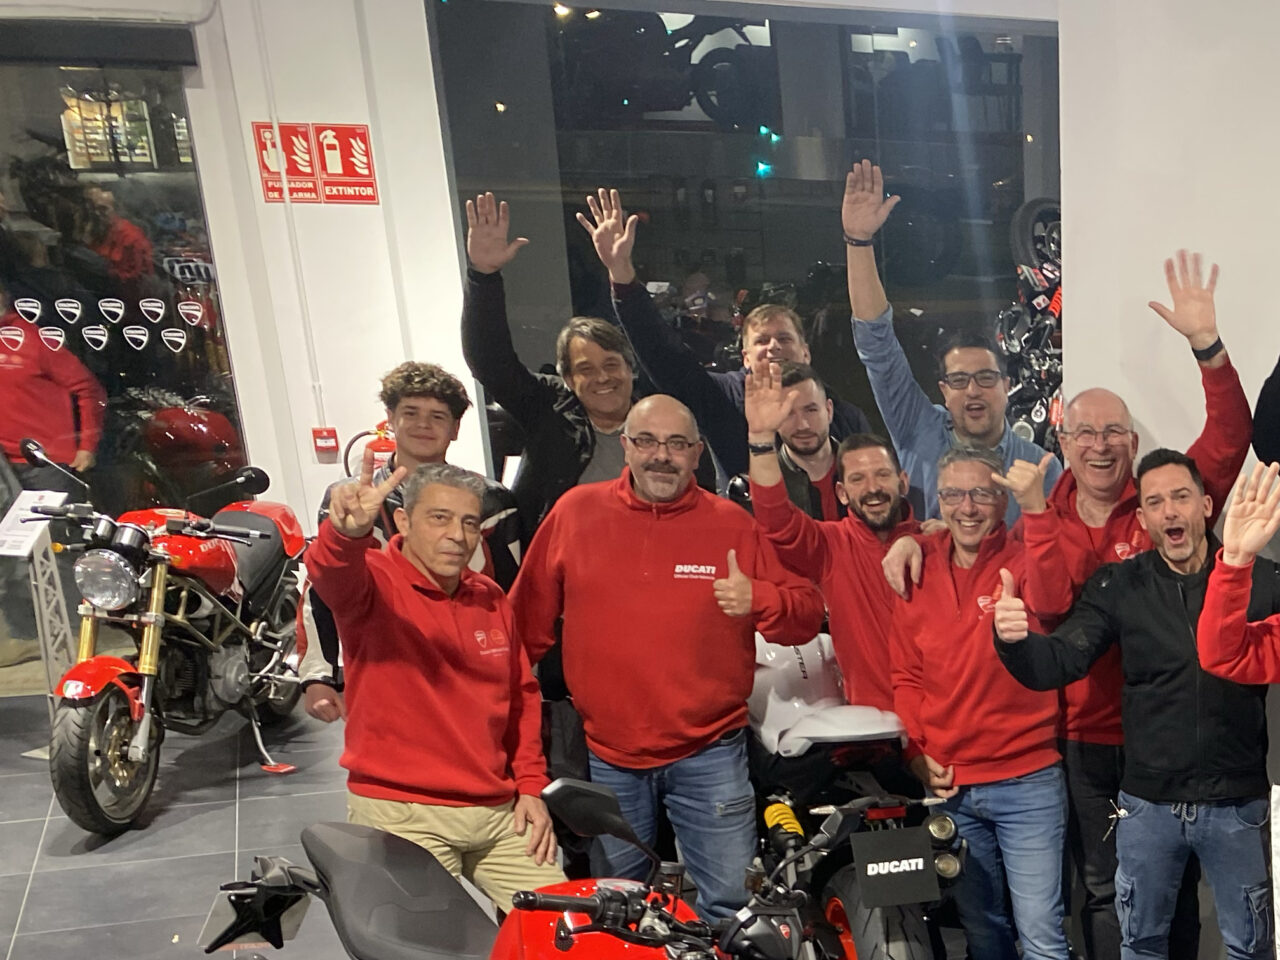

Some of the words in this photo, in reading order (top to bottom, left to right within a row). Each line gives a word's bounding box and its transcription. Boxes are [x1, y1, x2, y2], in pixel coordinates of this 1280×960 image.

[267, 181, 313, 189] PUADOR
[267, 191, 280, 199] DE
[289, 191, 317, 199] ARMA
[325, 186, 374, 196] EXTINTOR
[674, 564, 716, 574] DUCATI
[792, 645, 808, 679] STER
[866, 858, 924, 876] DUCATI
